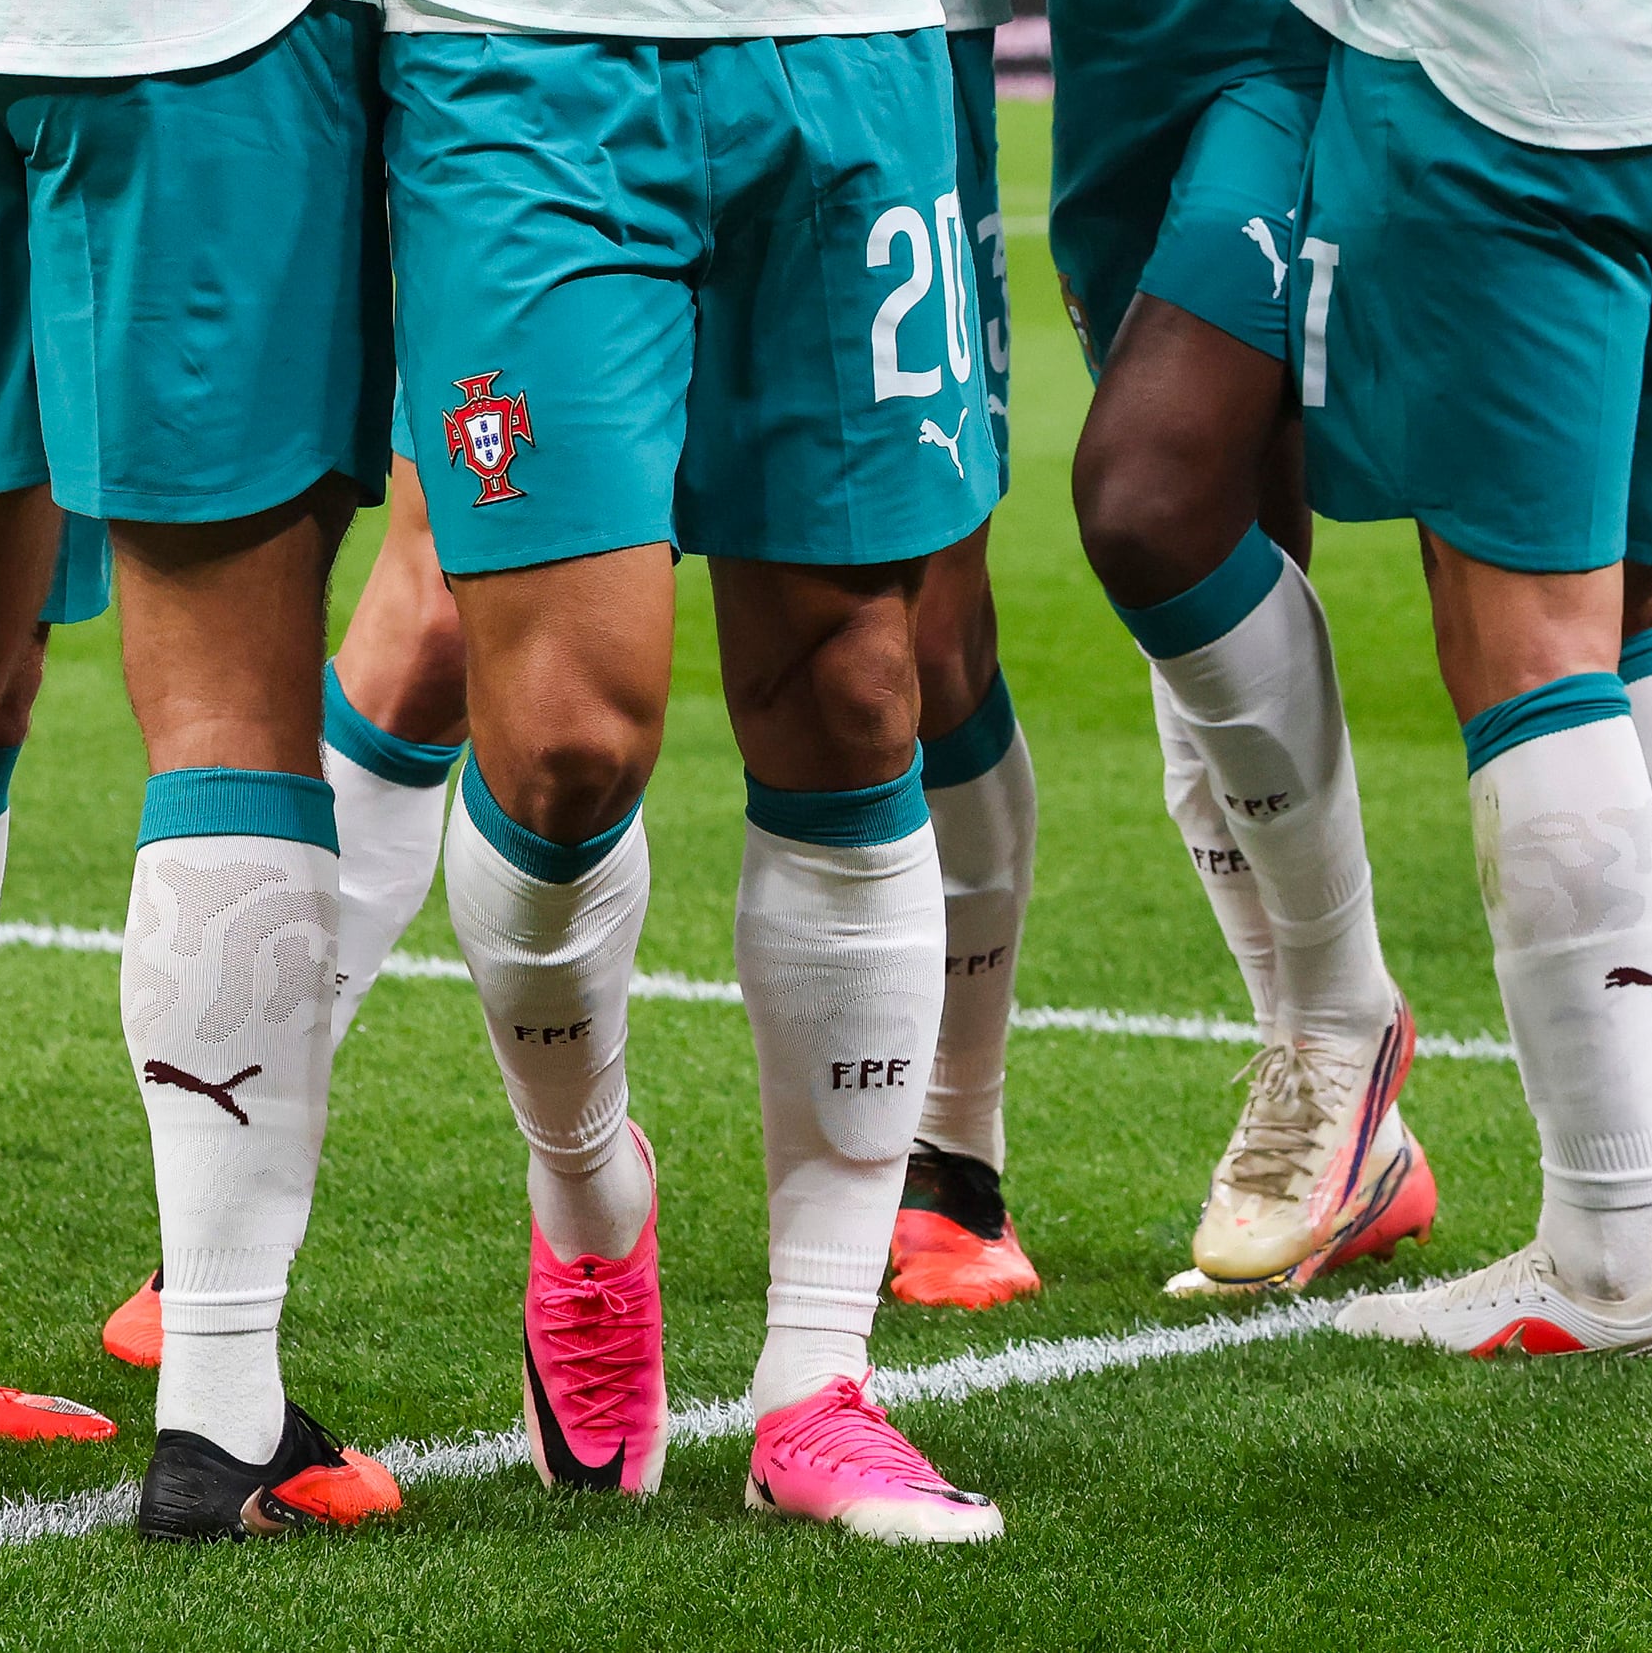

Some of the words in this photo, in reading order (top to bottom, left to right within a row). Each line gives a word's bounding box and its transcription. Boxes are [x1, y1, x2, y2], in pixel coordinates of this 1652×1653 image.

[866, 188, 973, 403] 20
[513, 1017, 593, 1045] F.P.F.
[831, 1058, 911, 1090] F.P.F.
